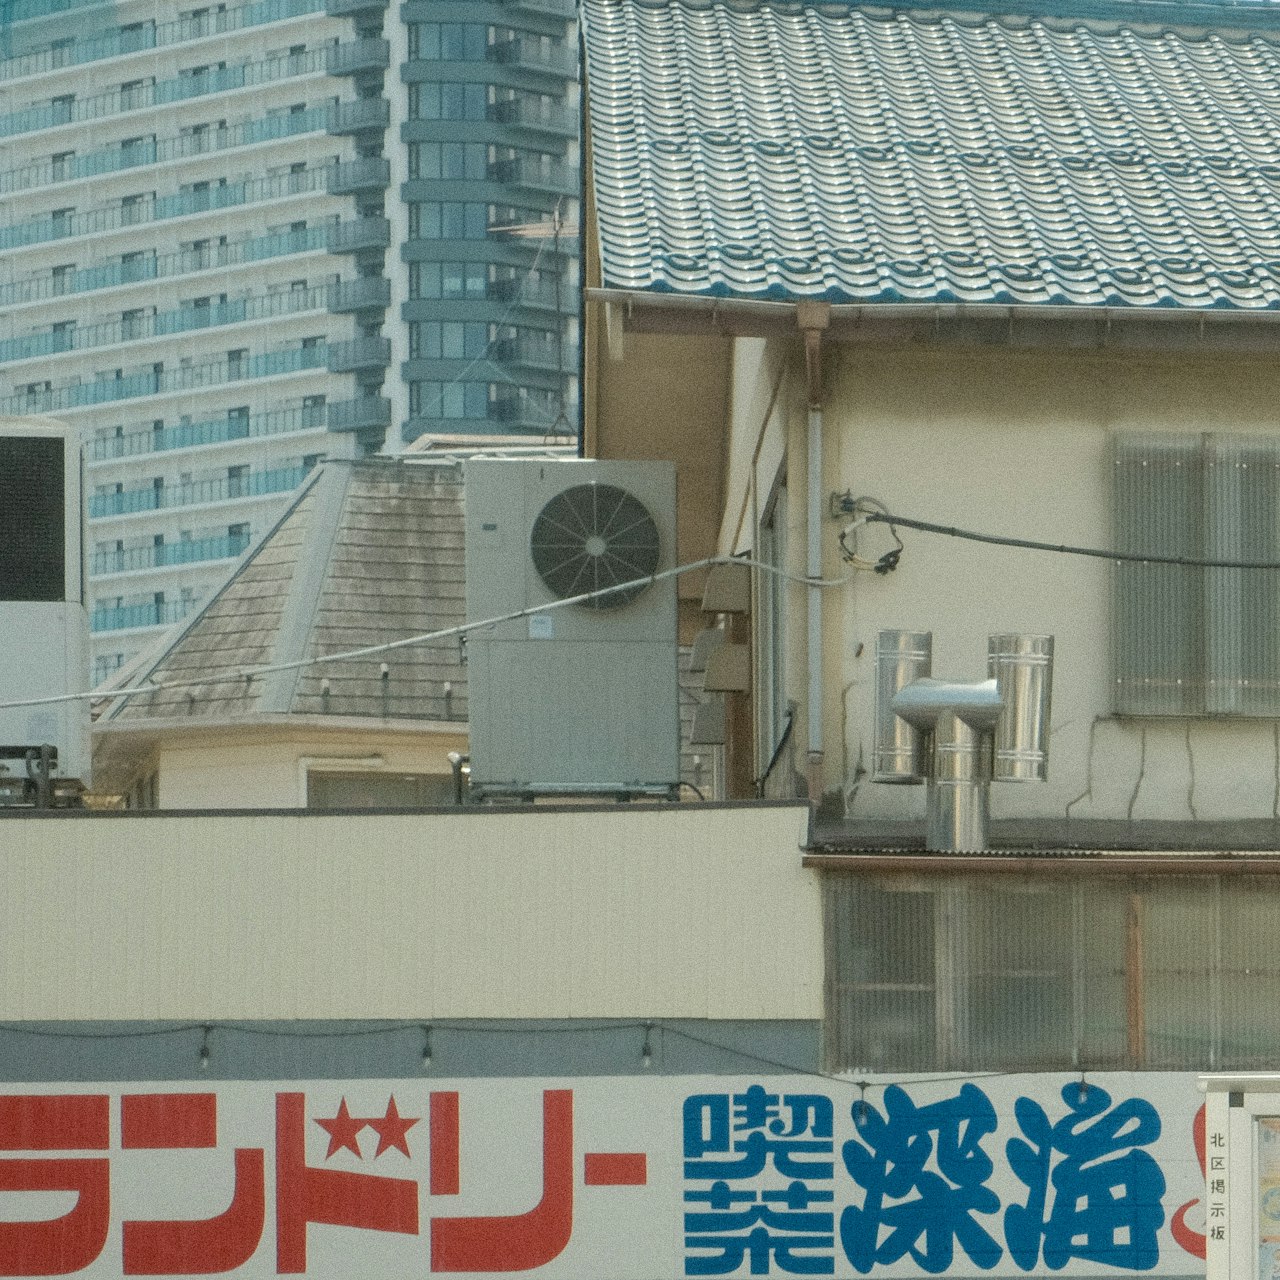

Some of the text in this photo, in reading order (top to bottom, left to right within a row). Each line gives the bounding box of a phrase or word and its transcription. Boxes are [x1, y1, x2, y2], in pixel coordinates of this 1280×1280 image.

[1210, 1132, 1226, 1240] 北区掲示板
